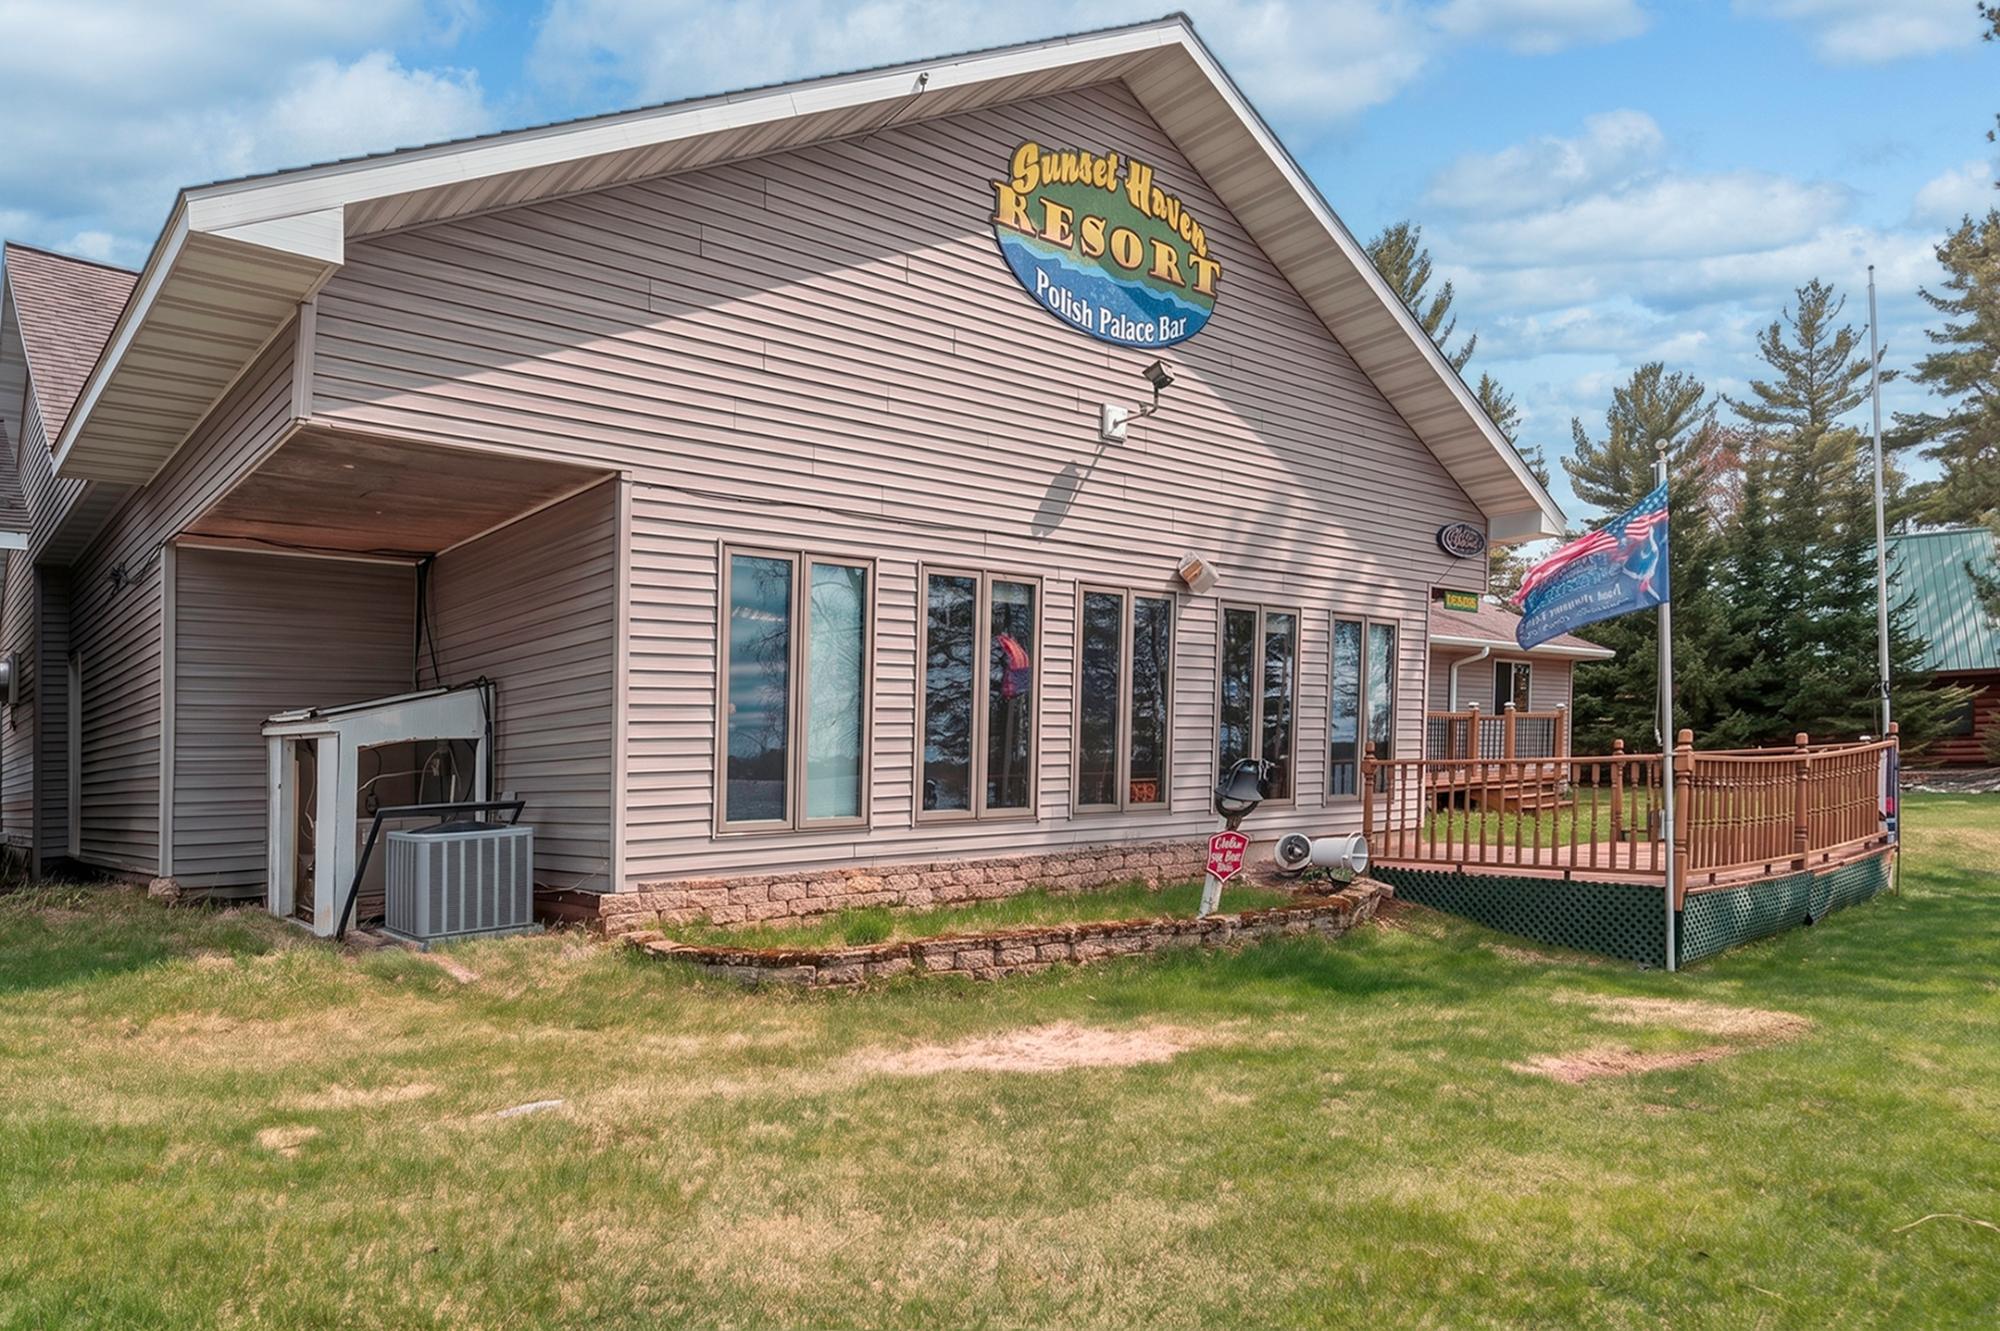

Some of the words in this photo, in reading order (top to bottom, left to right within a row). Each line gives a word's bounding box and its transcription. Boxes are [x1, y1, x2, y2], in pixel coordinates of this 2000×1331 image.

[993, 181, 1221, 298] RESORT
[1011, 141, 1118, 194] Sunset
[1124, 158, 1208, 258] Haven
[1035, 267, 1093, 330] Polish
[1099, 307, 1155, 343] Palace
[1159, 316, 1187, 342] Bar
